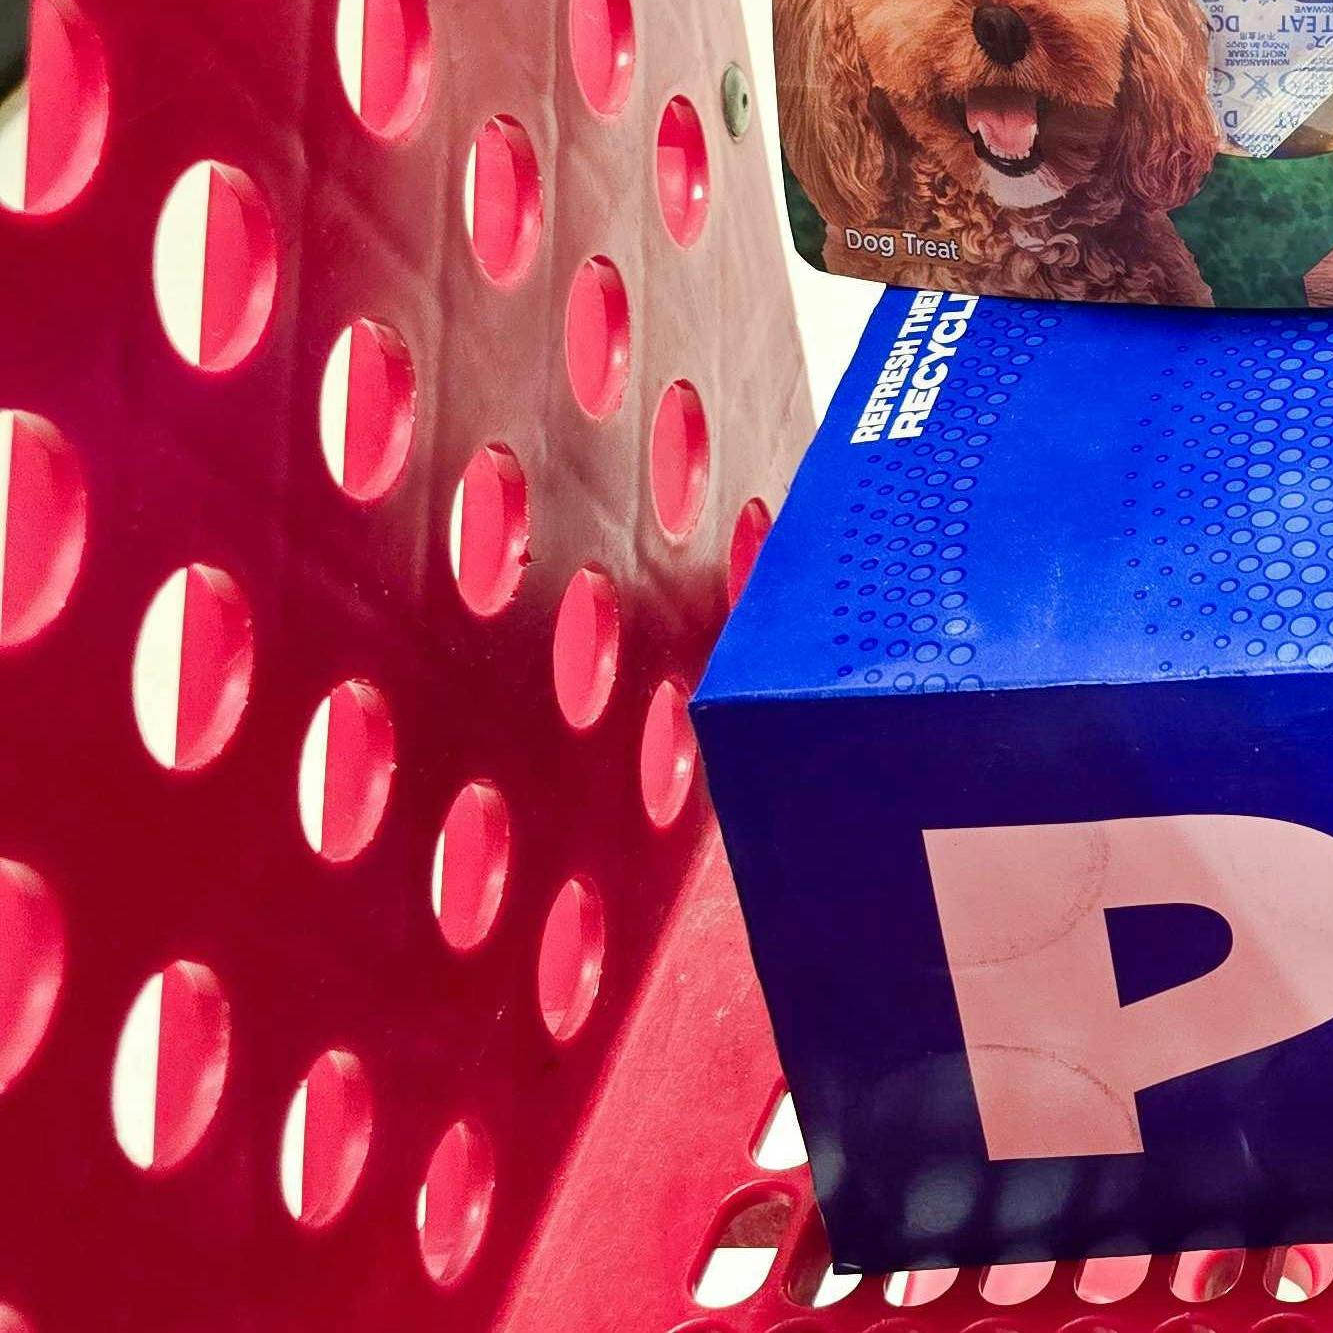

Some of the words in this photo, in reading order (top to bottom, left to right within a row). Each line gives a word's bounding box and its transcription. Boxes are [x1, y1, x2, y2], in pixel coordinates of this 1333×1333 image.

[1278, 15, 1317, 32] EAT
[845, 228, 895, 257] Dog
[902, 233, 960, 260] Treat
[850, 338, 923, 444] REFRESH
[898, 291, 944, 339] THE
